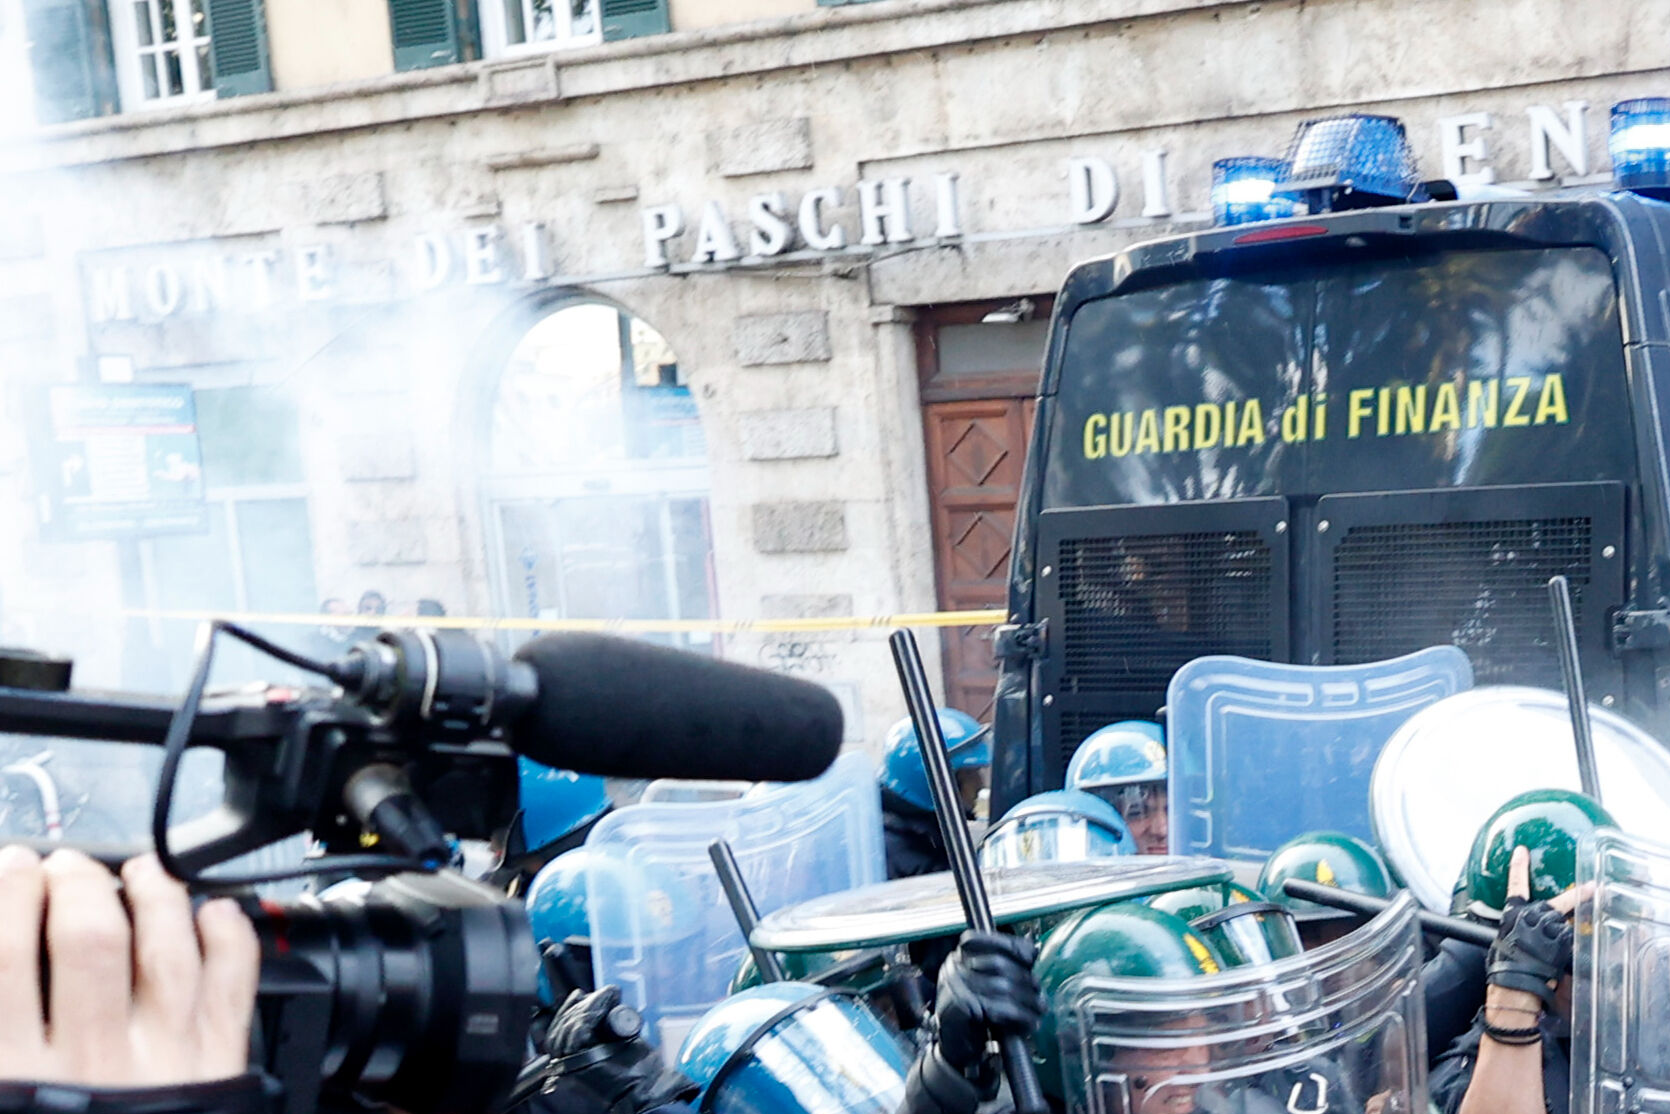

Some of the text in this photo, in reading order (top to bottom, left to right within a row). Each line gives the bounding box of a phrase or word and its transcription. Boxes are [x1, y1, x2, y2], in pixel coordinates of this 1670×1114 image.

[92, 148, 1171, 321] MONTE DEI PASCHI DI
[1083, 372, 1569, 459] GUARDIA di FINANZA
